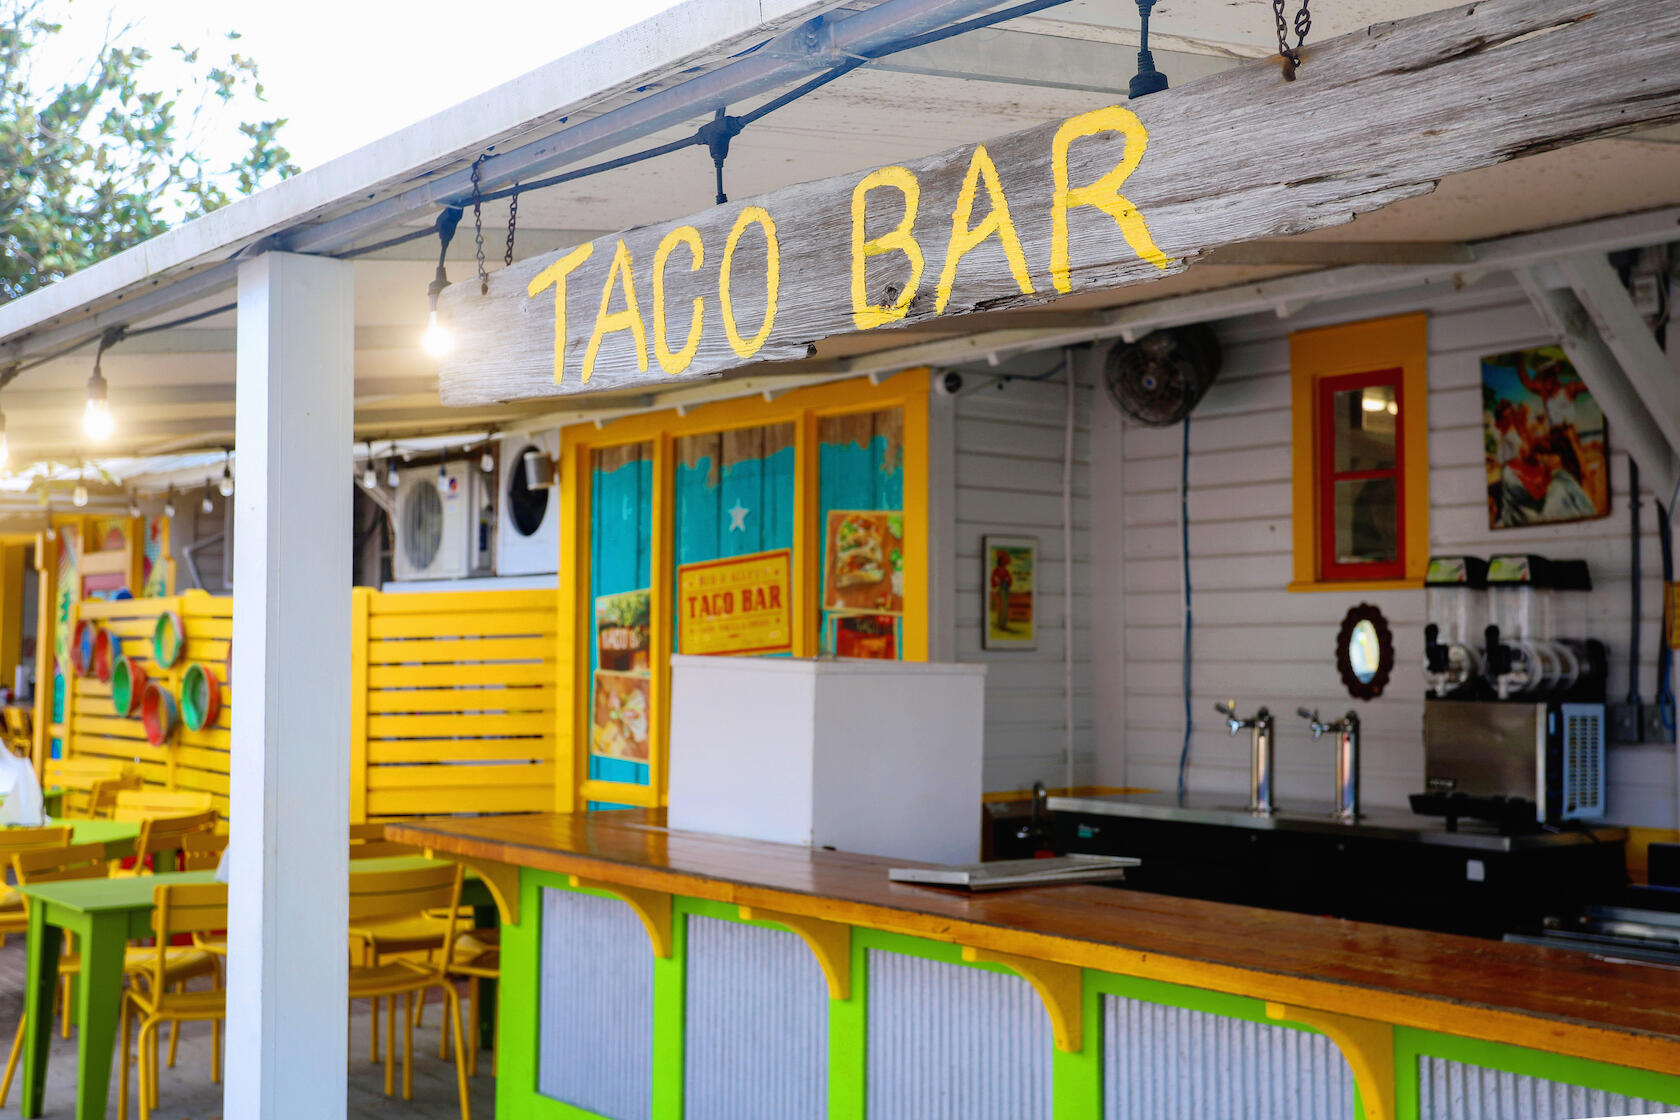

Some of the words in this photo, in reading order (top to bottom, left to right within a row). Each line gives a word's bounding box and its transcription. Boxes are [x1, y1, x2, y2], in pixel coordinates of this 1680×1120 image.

[528, 206, 779, 384] TACO
[851, 105, 1175, 330] BAR
[688, 591, 734, 619] TACO
[741, 585, 782, 612] BAR
